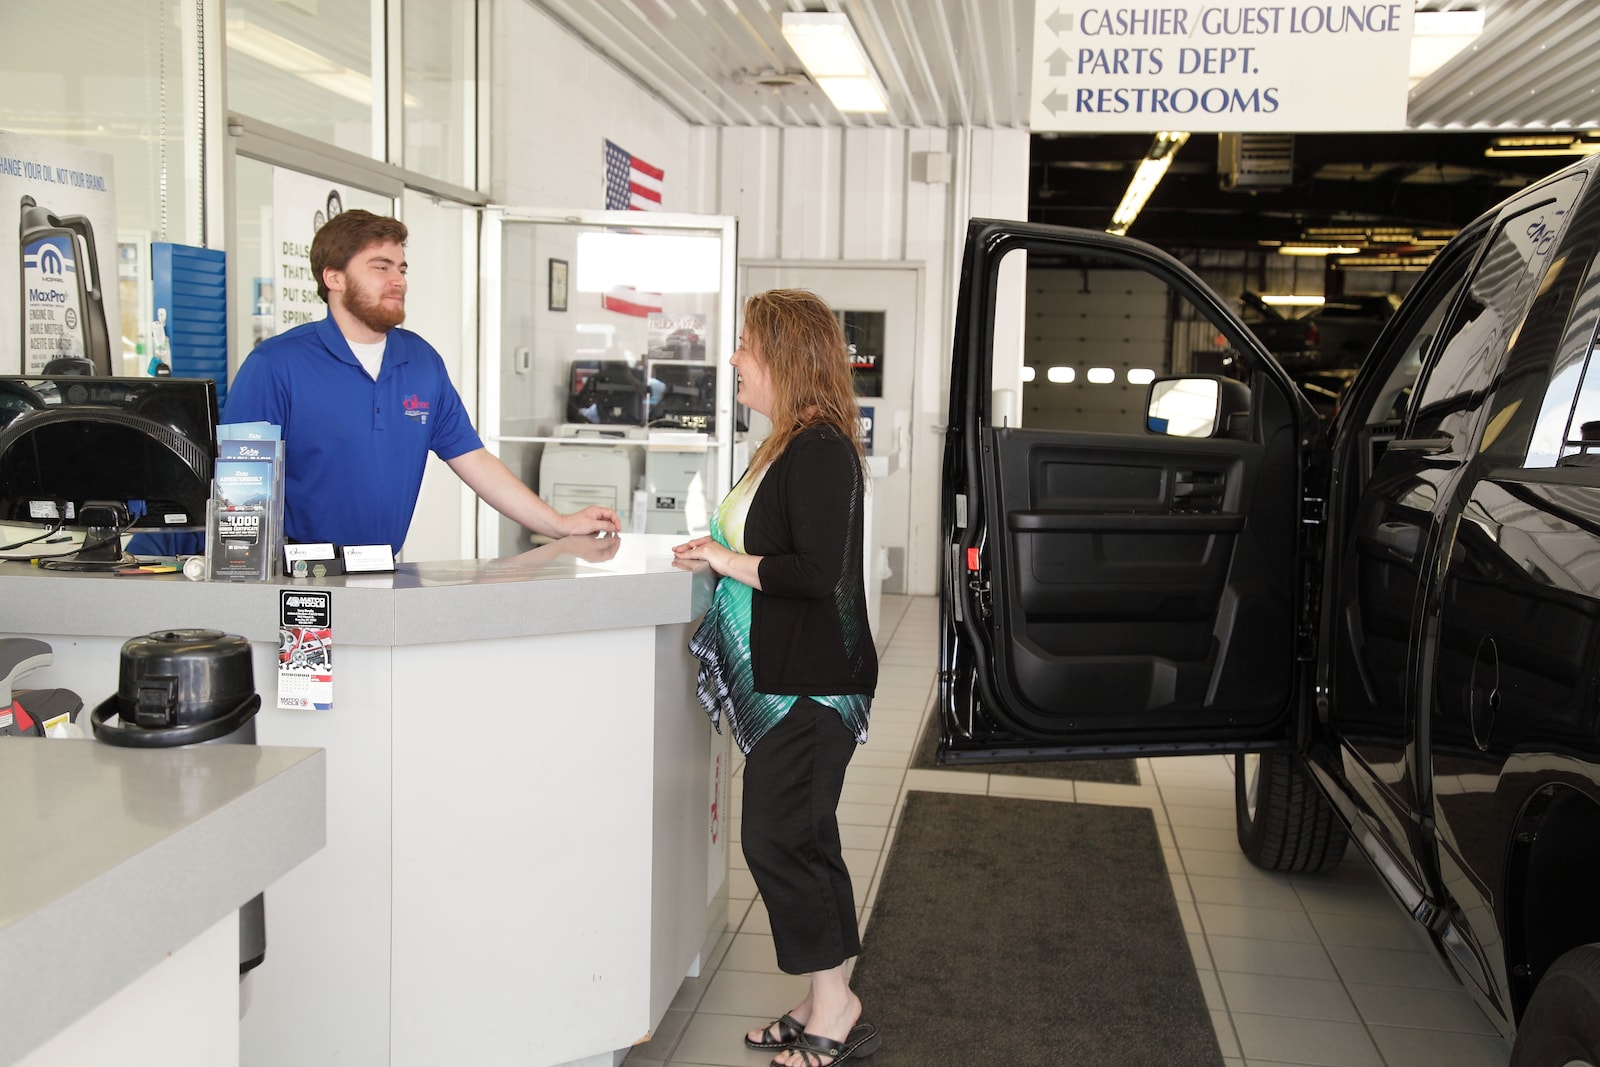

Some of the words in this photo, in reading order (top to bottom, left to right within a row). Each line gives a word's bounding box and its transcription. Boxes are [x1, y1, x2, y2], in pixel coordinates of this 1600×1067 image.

[1079, 6, 1285, 39] CASHIER/GUEST
[1289, 4, 1401, 34] LOUNGE
[1077, 47, 1163, 75] PARTS
[1178, 47, 1260, 75] DEPT.
[1075, 87, 1280, 114] RESTROOMS
[23, 160, 42, 181] YOUR
[56, 167, 69, 185] NOT
[69, 170, 86, 188] YOUR
[283, 241, 310, 258] DEALS
[283, 287, 299, 302] PUT
[29, 309, 47, 320] ENGINE
[47, 309, 55, 321] OIL
